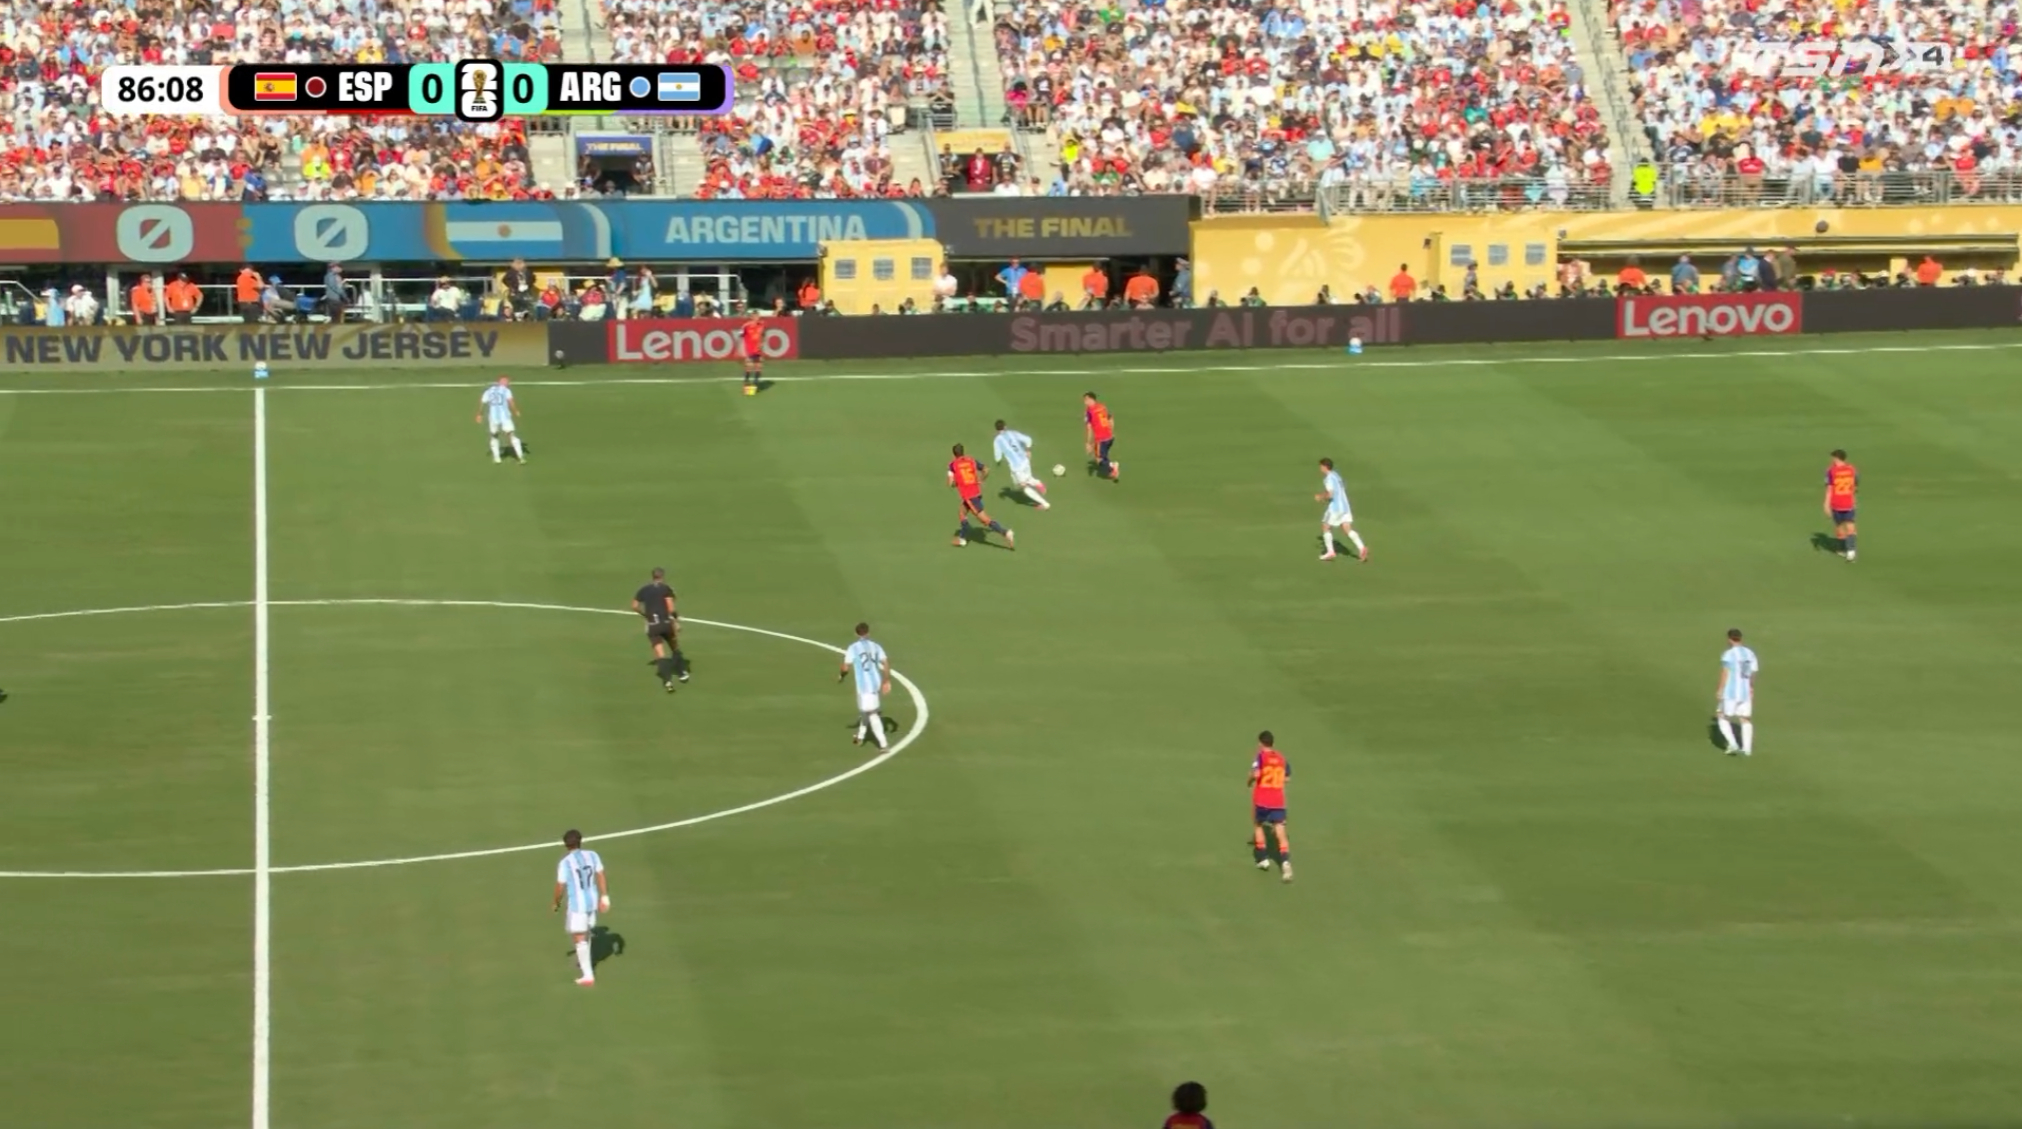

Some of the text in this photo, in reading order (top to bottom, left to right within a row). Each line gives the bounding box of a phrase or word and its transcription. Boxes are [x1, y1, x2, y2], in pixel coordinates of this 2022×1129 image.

[664, 215, 868, 244] ARGENTINA
[974, 216, 1133, 239] THE FINAL
[1010, 307, 1400, 352] Smarter AI for all
[1624, 300, 1794, 336] Lenovo
[6, 330, 498, 363] NEW YORK NEW JERSEY
[859, 651, 879, 673] 24
[576, 865, 593, 890] 17
